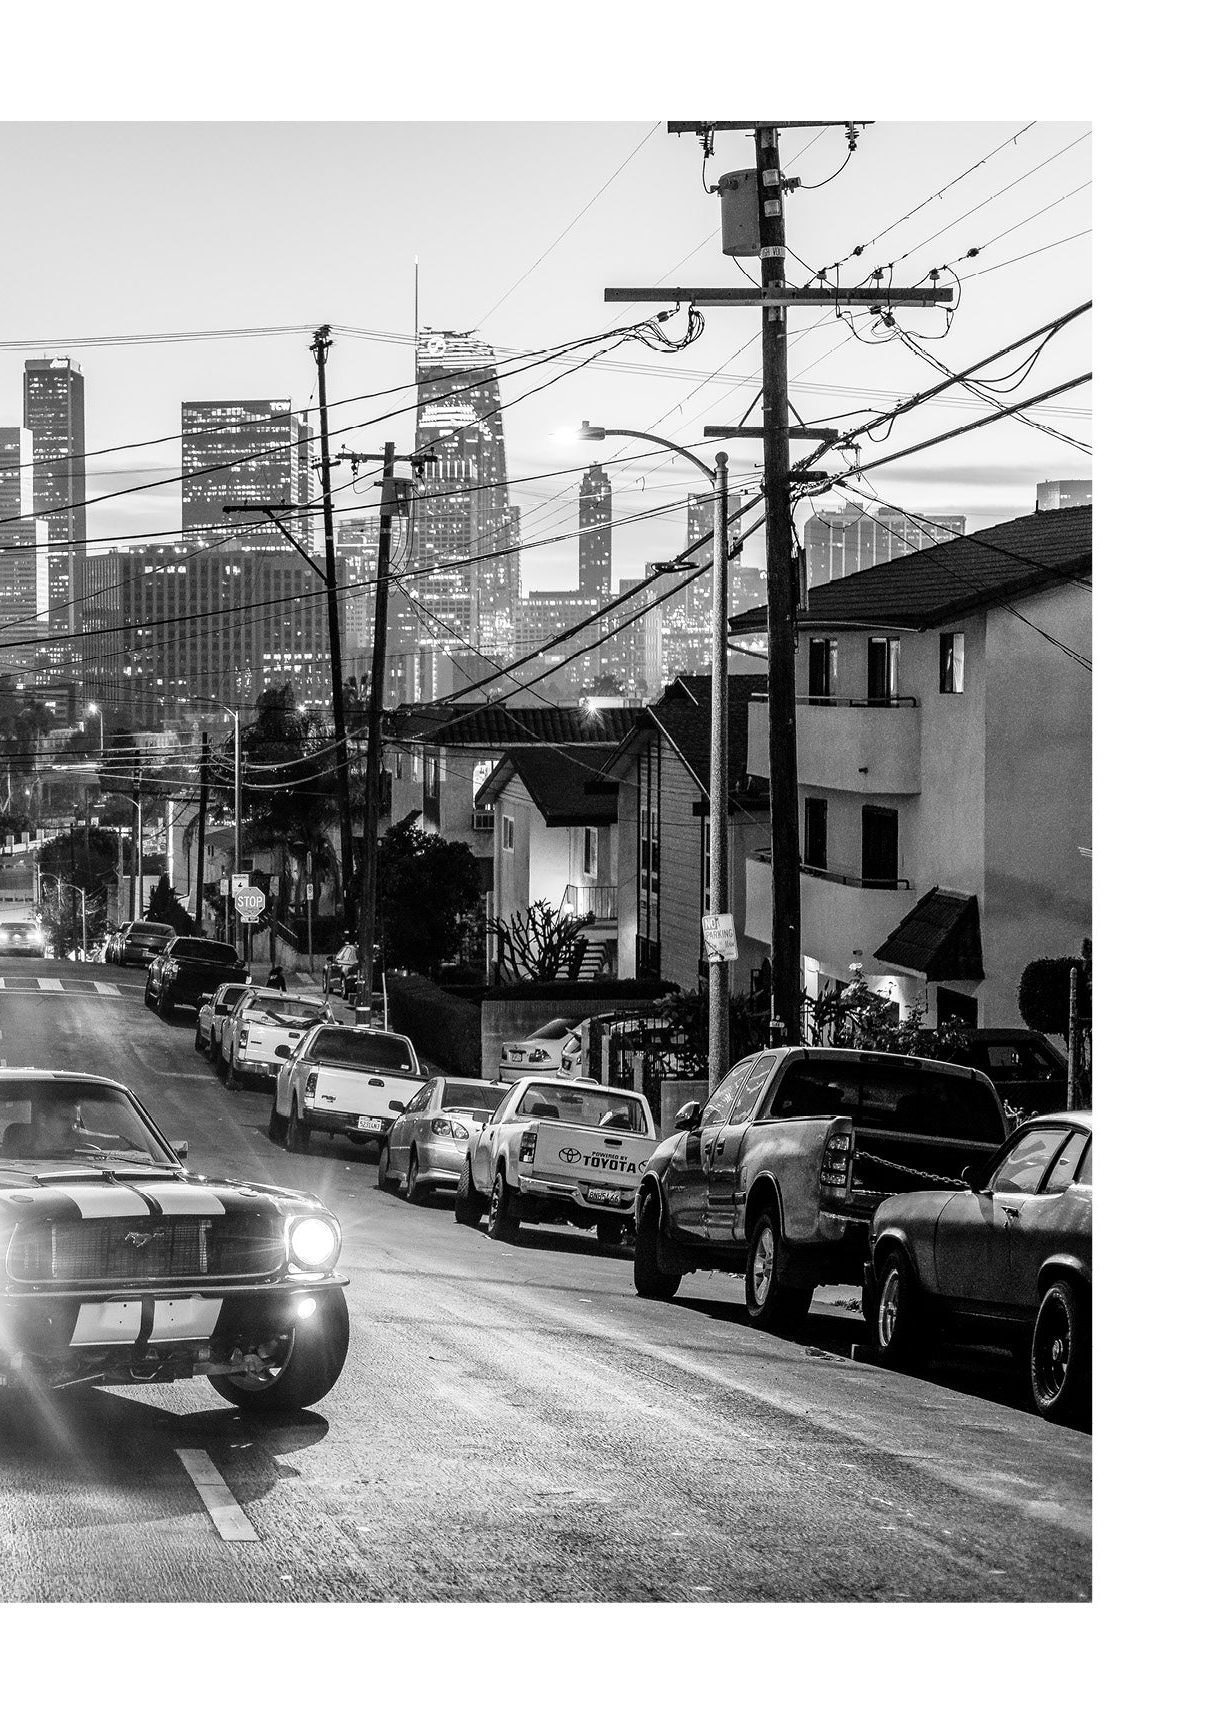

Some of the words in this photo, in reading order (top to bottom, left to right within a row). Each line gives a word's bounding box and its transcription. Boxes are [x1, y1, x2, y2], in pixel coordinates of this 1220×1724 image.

[270, 402, 290, 411] TCW
[237, 896, 263, 907] STOP
[705, 928, 734, 940] PARKING
[592, 1151, 619, 1160] POWERED
[583, 1155, 637, 1174] TOYOTA
